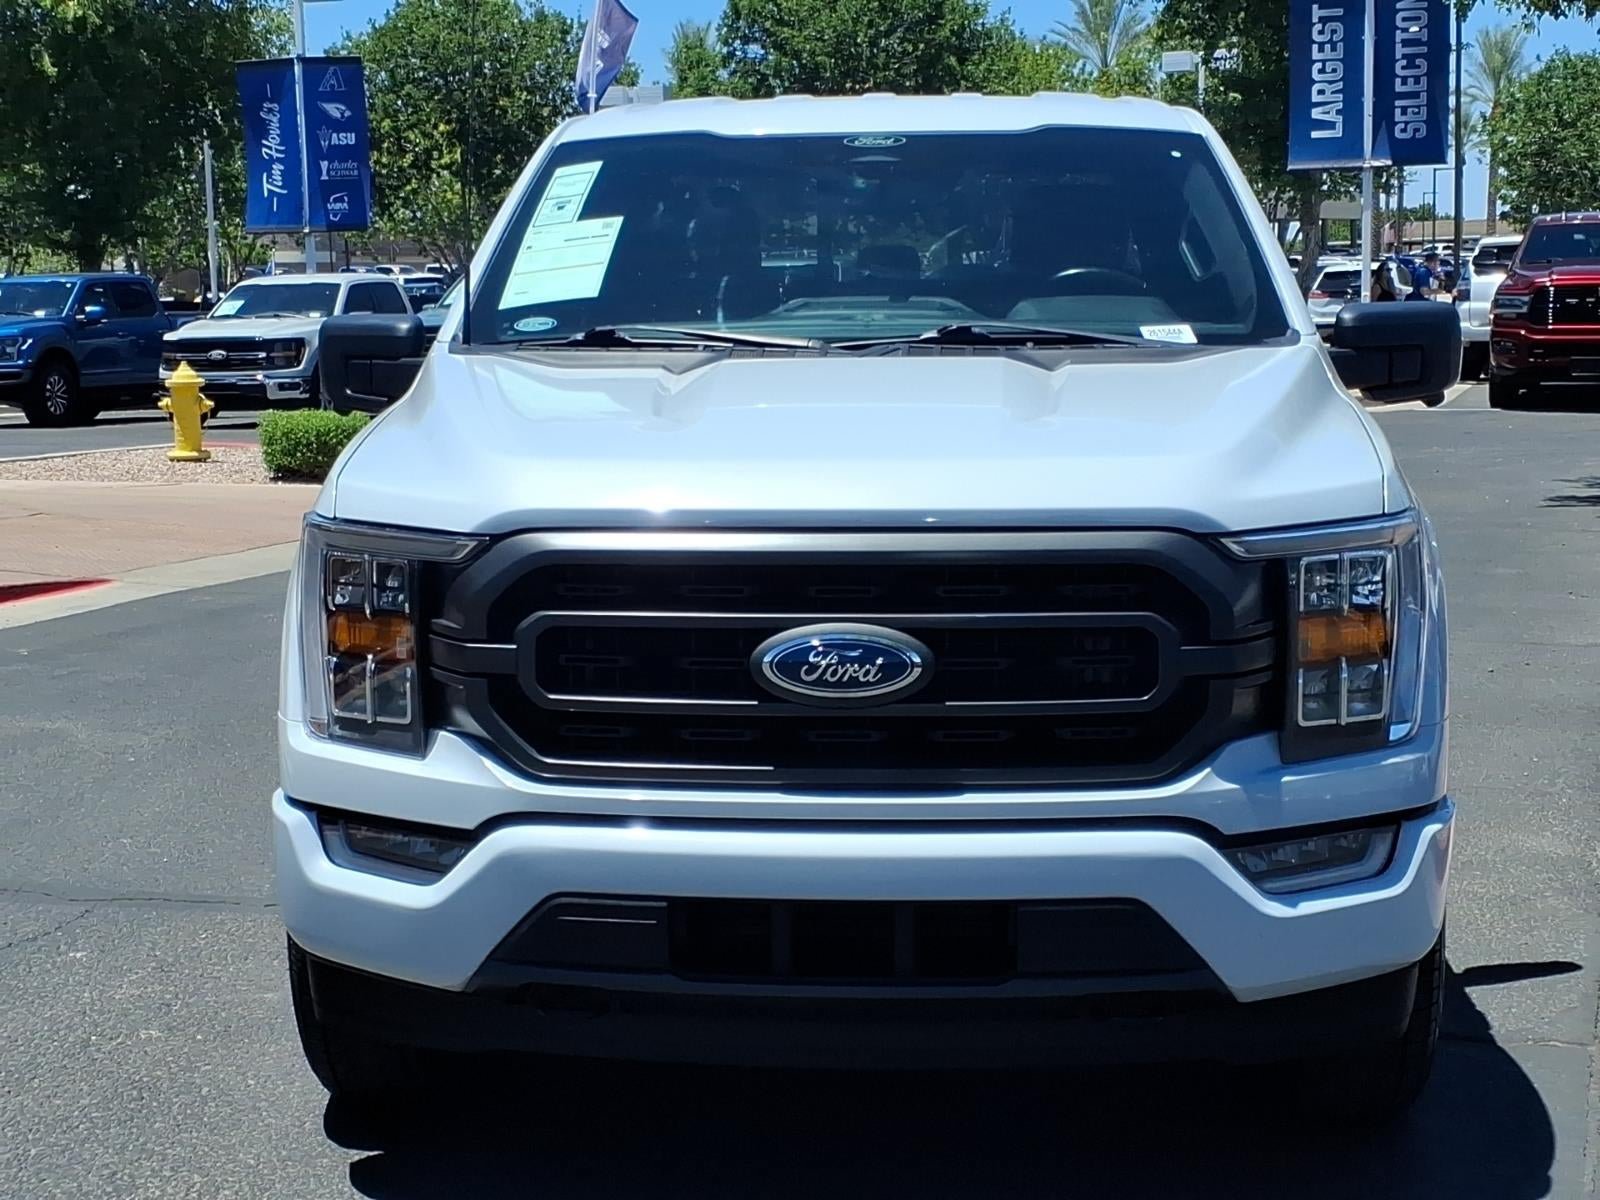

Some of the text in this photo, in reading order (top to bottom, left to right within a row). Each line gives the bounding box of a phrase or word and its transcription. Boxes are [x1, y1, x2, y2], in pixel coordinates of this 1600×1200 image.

[1311, 4, 1344, 139] LARGEST
[259, 101, 288, 198] Tim Hovik's
[331, 132, 356, 145] ASU
[800, 646, 884, 682] Ford
